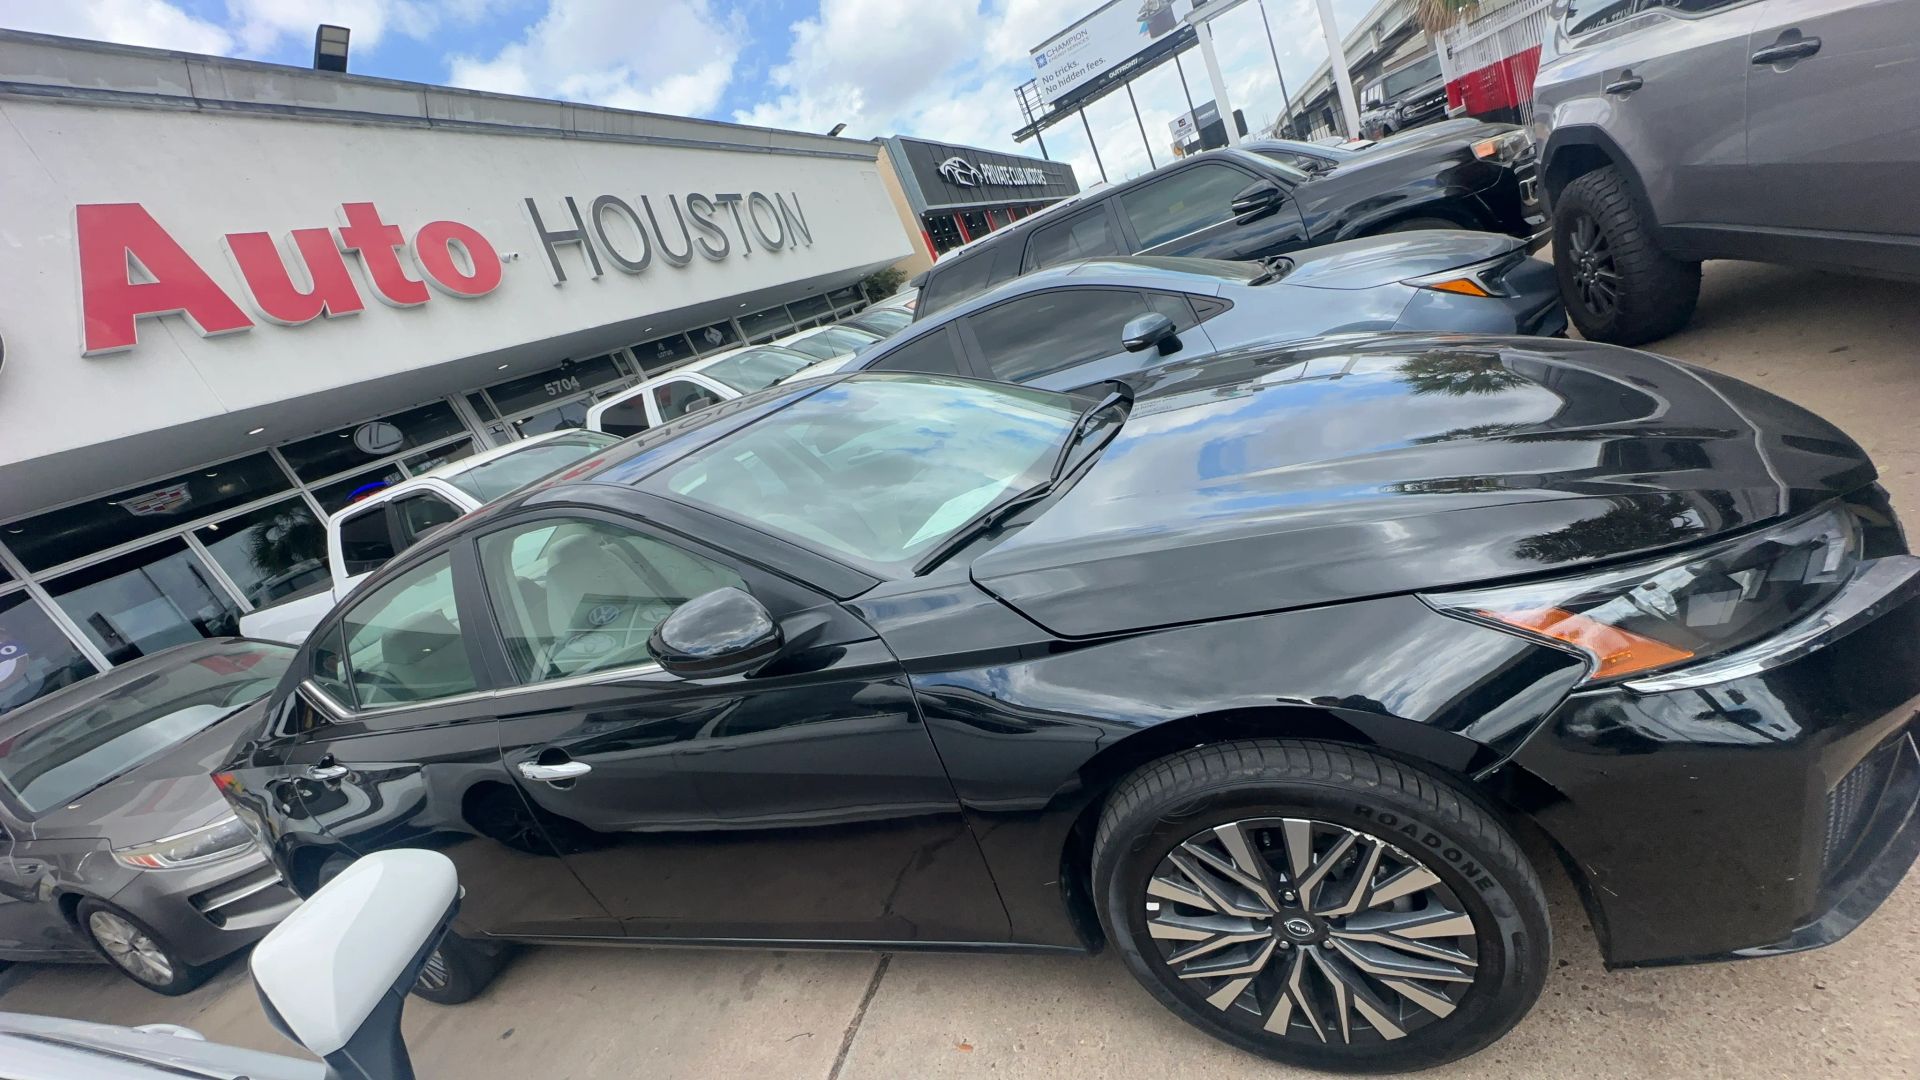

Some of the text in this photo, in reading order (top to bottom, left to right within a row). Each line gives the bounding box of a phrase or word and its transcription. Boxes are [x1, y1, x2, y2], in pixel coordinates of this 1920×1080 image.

[1046, 29, 1088, 57] CHAMPION
[1042, 60, 1080, 85] No tricks.
[1045, 57, 1106, 95] No hidden fees.
[980, 163, 1047, 185] PRIVATE CLUB MOTORS
[76, 191, 814, 357] Auto HOUSTON
[545, 375, 580, 395] 5704
[1354, 804, 1495, 891] ROADONE
